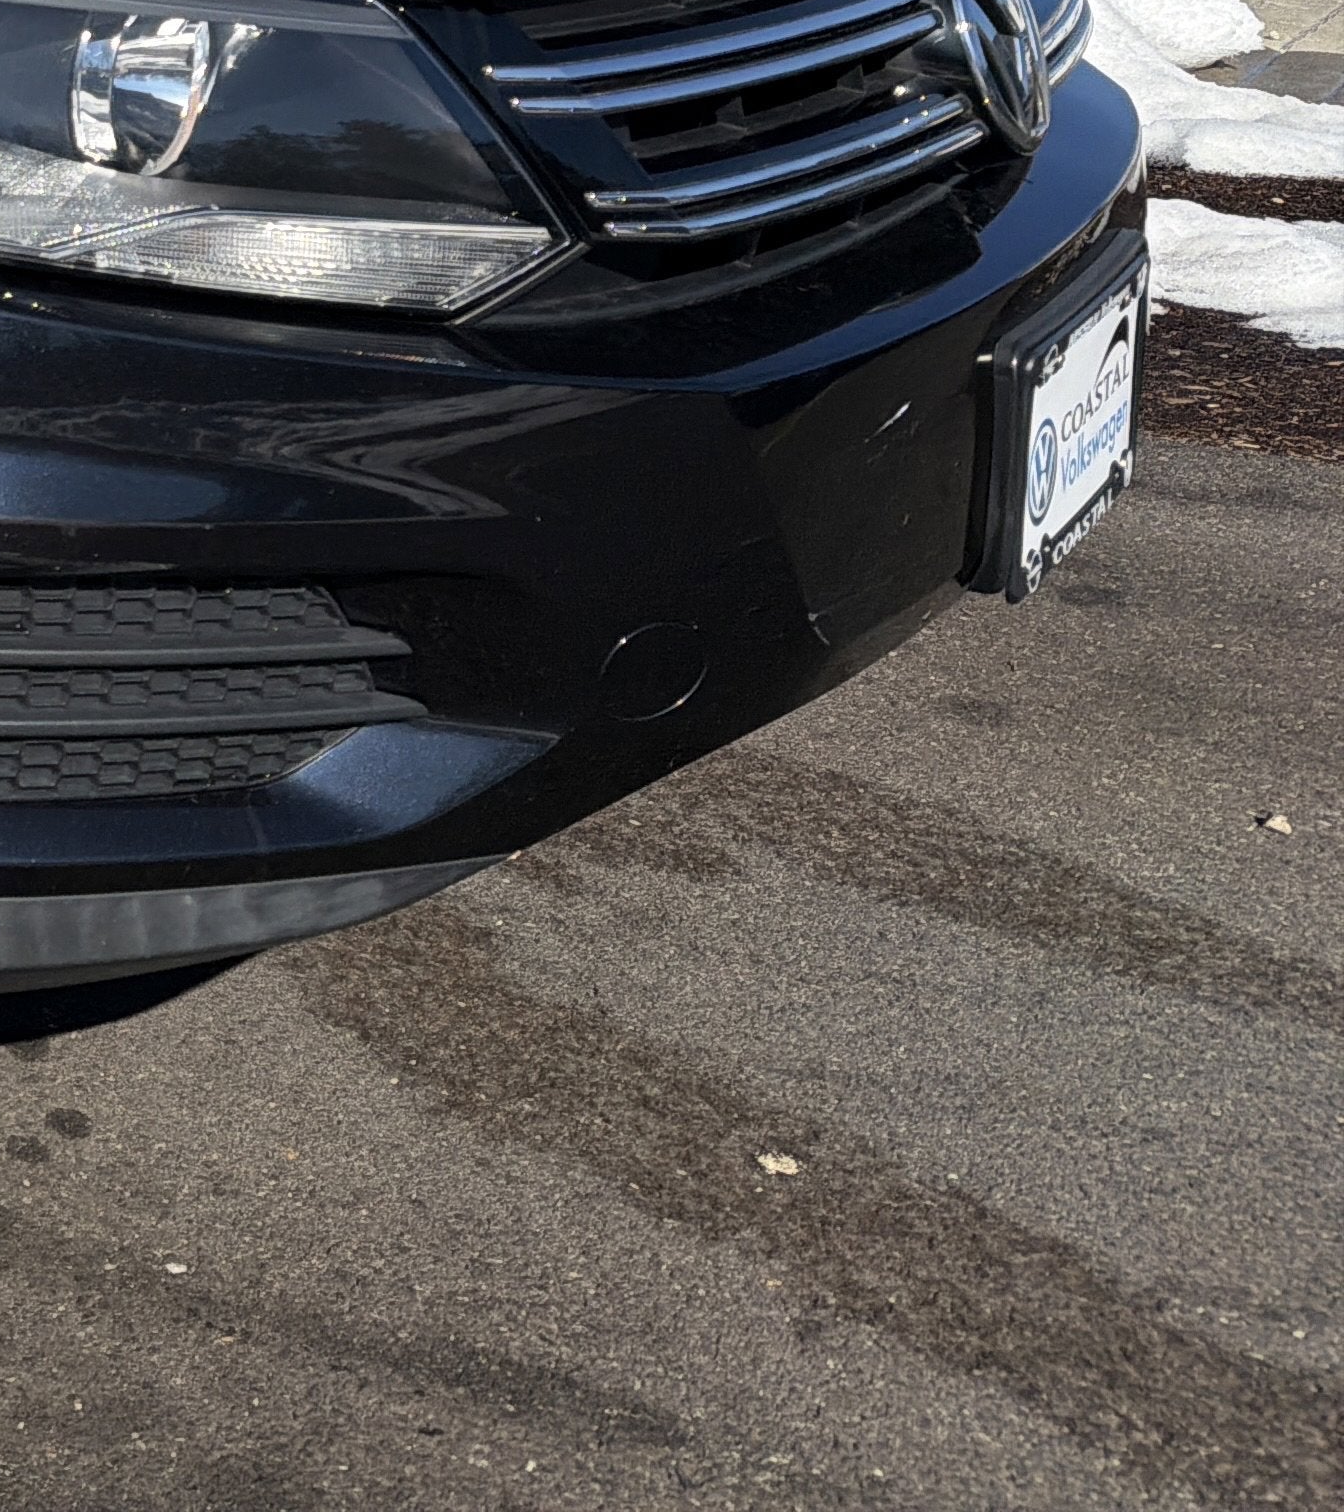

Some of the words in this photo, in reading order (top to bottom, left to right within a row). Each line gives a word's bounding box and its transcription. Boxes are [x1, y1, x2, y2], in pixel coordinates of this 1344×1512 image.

[1061, 353, 1129, 443] COASTAL
[1061, 400, 1128, 492] Volkswagen
[1052, 488, 1114, 565] COASTAL
